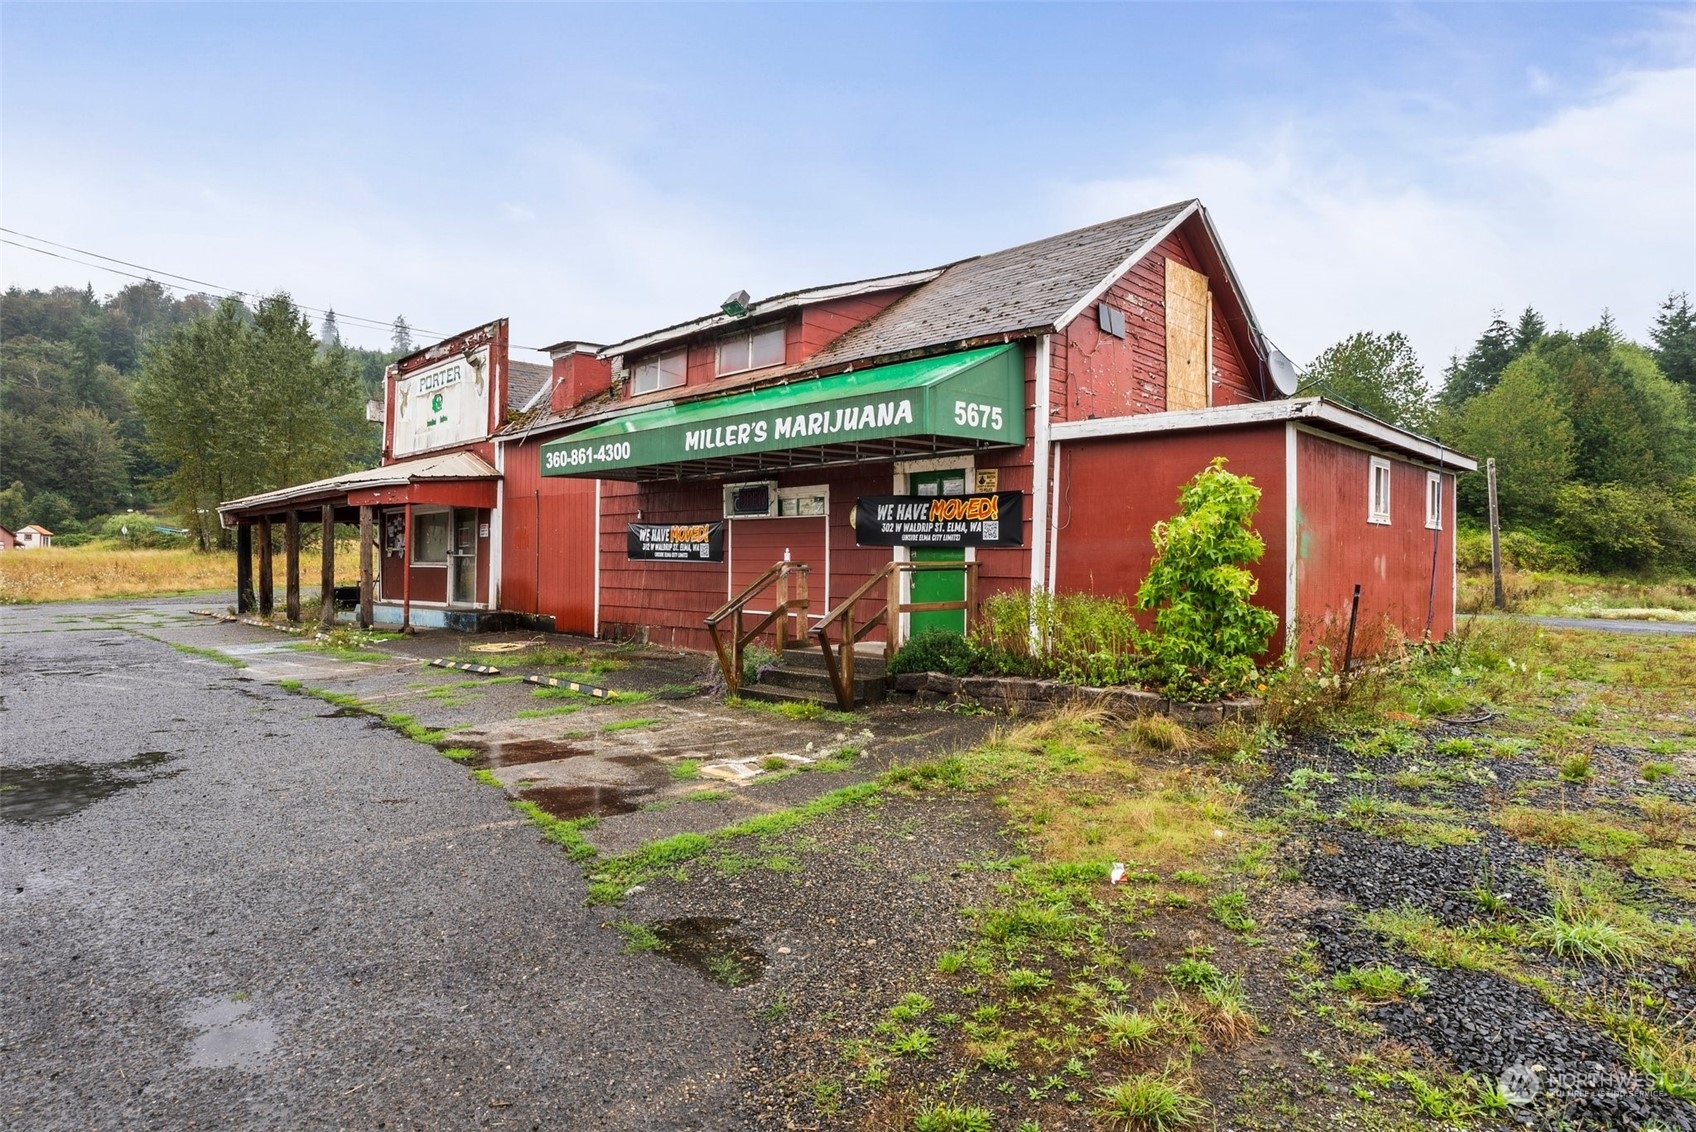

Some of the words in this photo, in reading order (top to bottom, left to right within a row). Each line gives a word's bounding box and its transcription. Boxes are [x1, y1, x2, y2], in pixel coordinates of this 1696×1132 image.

[420, 366, 461, 392] PORTER
[685, 421, 768, 451] MILLER'S
[774, 399, 913, 439] MARIJUANA
[954, 400, 1003, 430] 5675
[546, 442, 631, 469] 360-861-4300
[877, 504, 893, 521] WE
[896, 503, 929, 520] HAVE
[929, 495, 999, 521] MOVED!
[640, 528, 650, 542] WE
[651, 528, 669, 541] HAVE
[670, 524, 709, 543] MOVED!
[881, 523, 894, 533] 302
[895, 523, 902, 532] W
[903, 522, 933, 533] WALDRIP
[934, 522, 945, 533] ST.
[947, 522, 967, 533] ELMA,
[970, 522, 982, 532] WA
